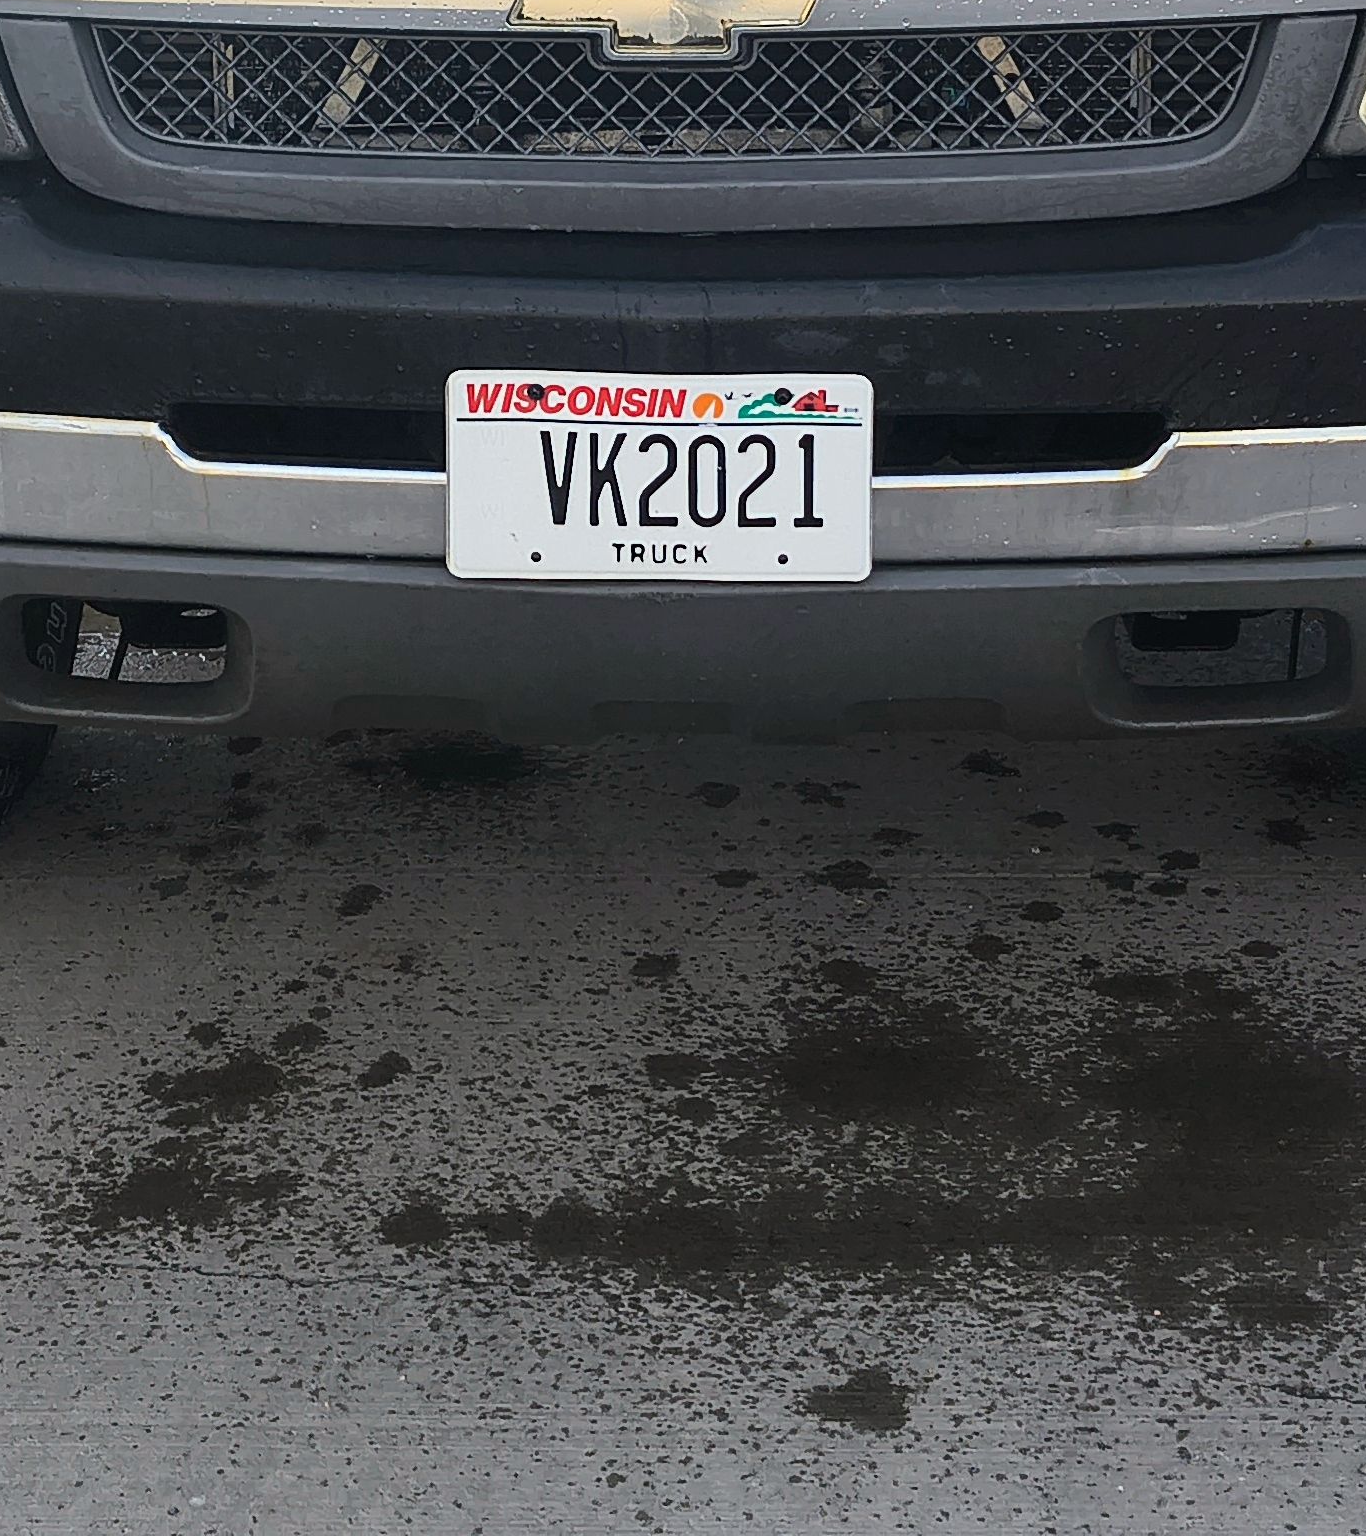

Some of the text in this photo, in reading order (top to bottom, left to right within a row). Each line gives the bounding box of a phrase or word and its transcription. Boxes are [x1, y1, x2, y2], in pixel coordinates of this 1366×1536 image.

[466, 383, 687, 418] WISCONSIN
[540, 430, 824, 527] VK2021
[612, 543, 709, 564] TRUCK
